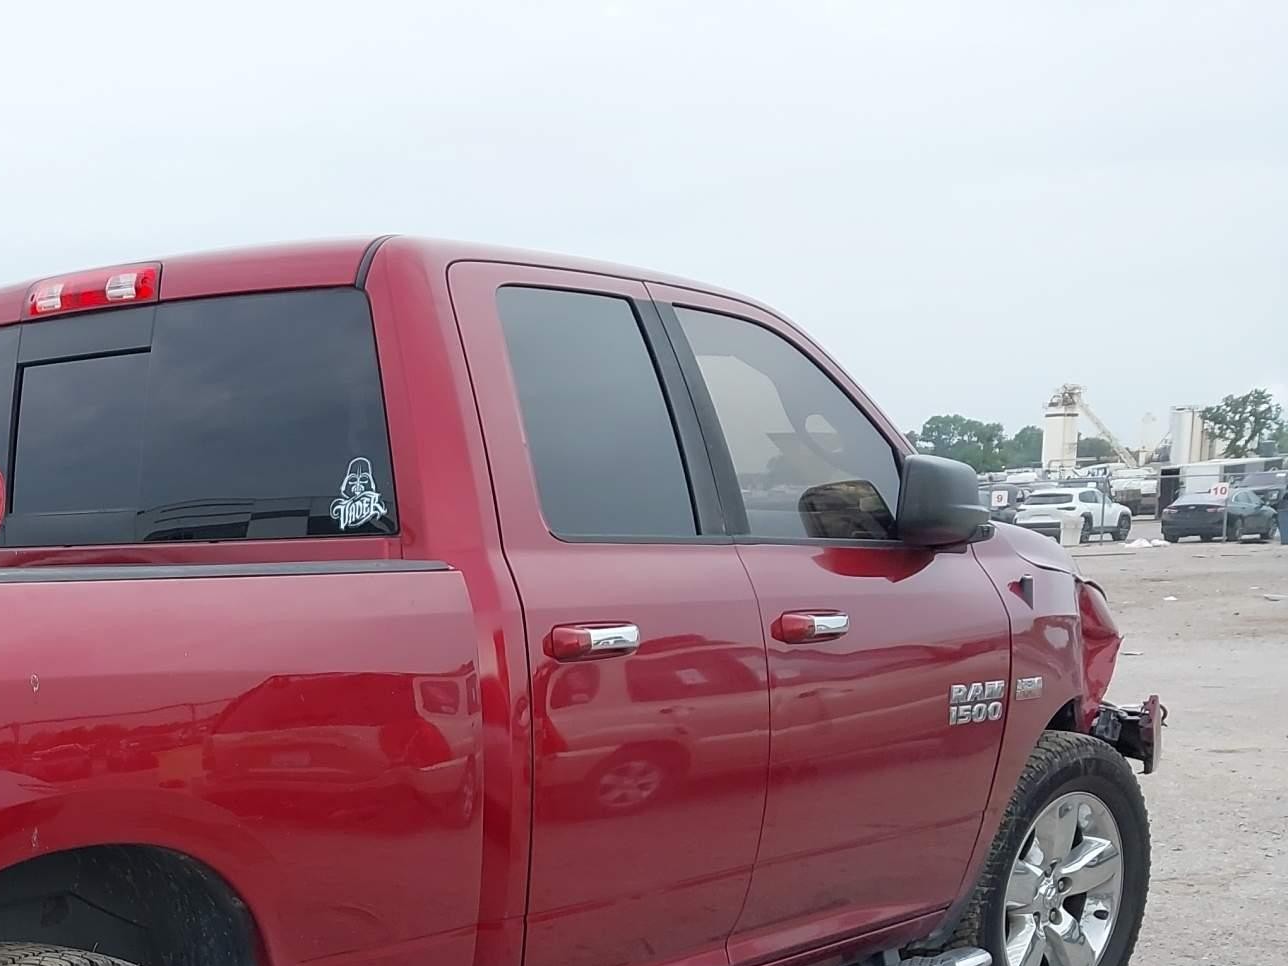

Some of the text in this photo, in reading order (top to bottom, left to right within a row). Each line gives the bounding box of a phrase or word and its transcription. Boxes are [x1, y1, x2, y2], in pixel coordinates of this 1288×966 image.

[995, 494, 1003, 503] 9
[1213, 486, 1228, 496] 10
[330, 491, 387, 530] VADER
[950, 680, 1005, 703] RAM
[949, 702, 1003, 726] 1500
